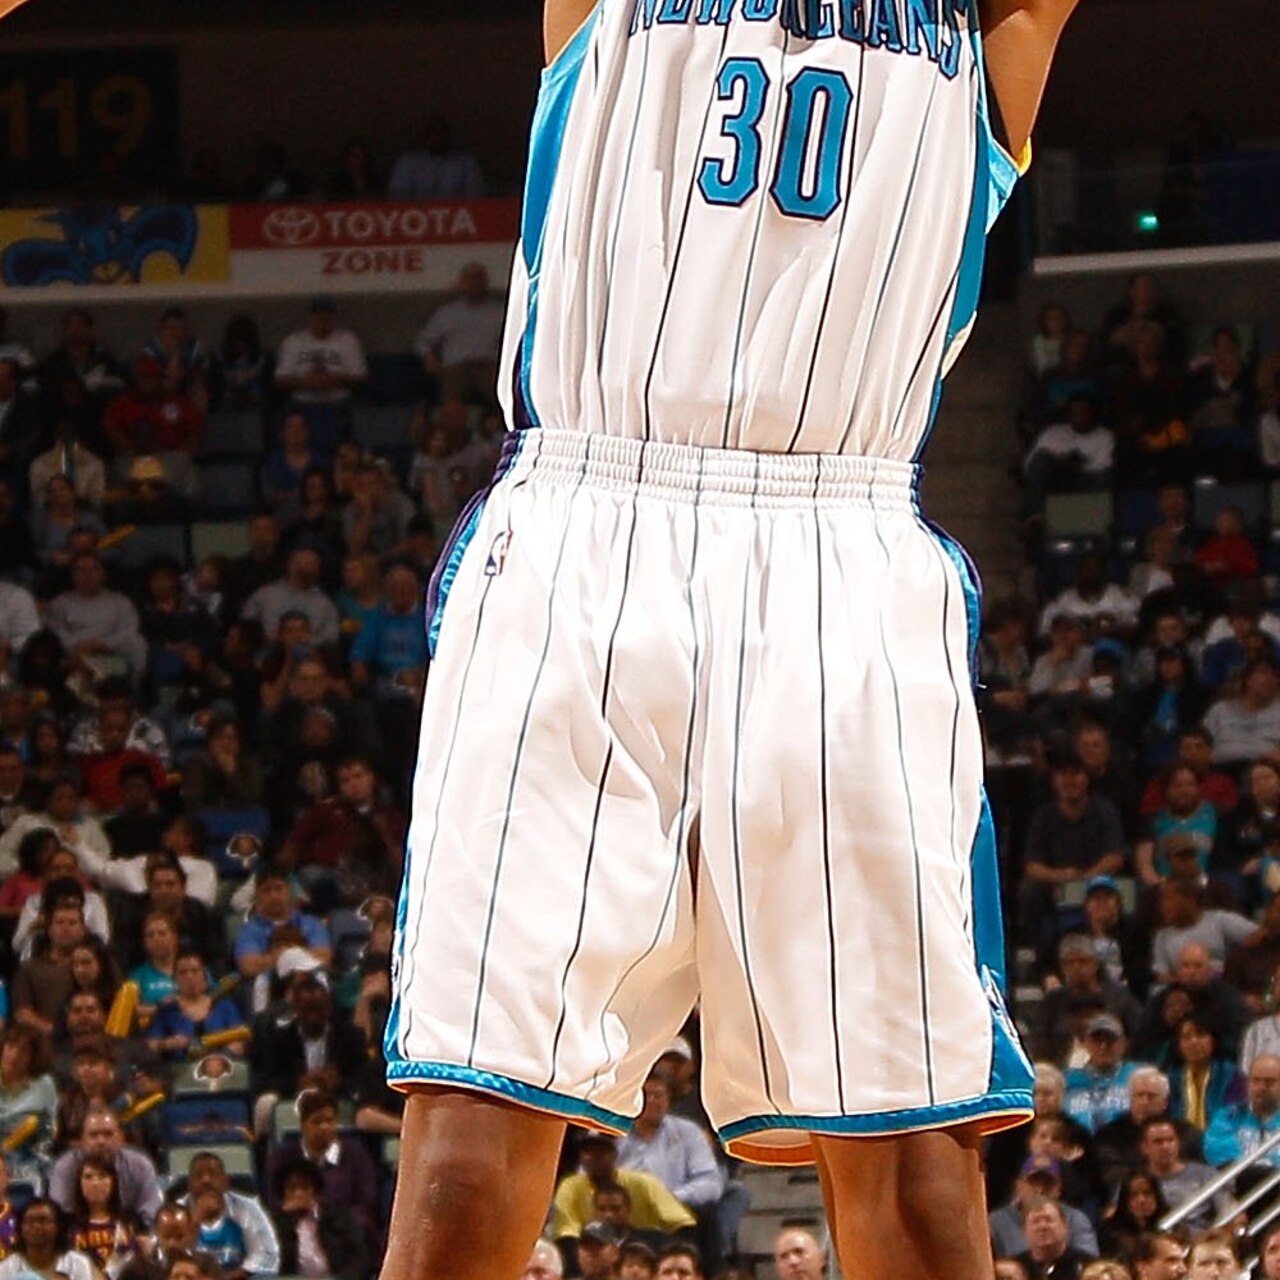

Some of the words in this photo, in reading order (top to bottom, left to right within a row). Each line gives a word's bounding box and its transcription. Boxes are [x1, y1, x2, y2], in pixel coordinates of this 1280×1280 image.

[697, 57, 853, 220] 30
[323, 207, 477, 239] TOYOTA
[323, 250, 423, 274] ZONE
